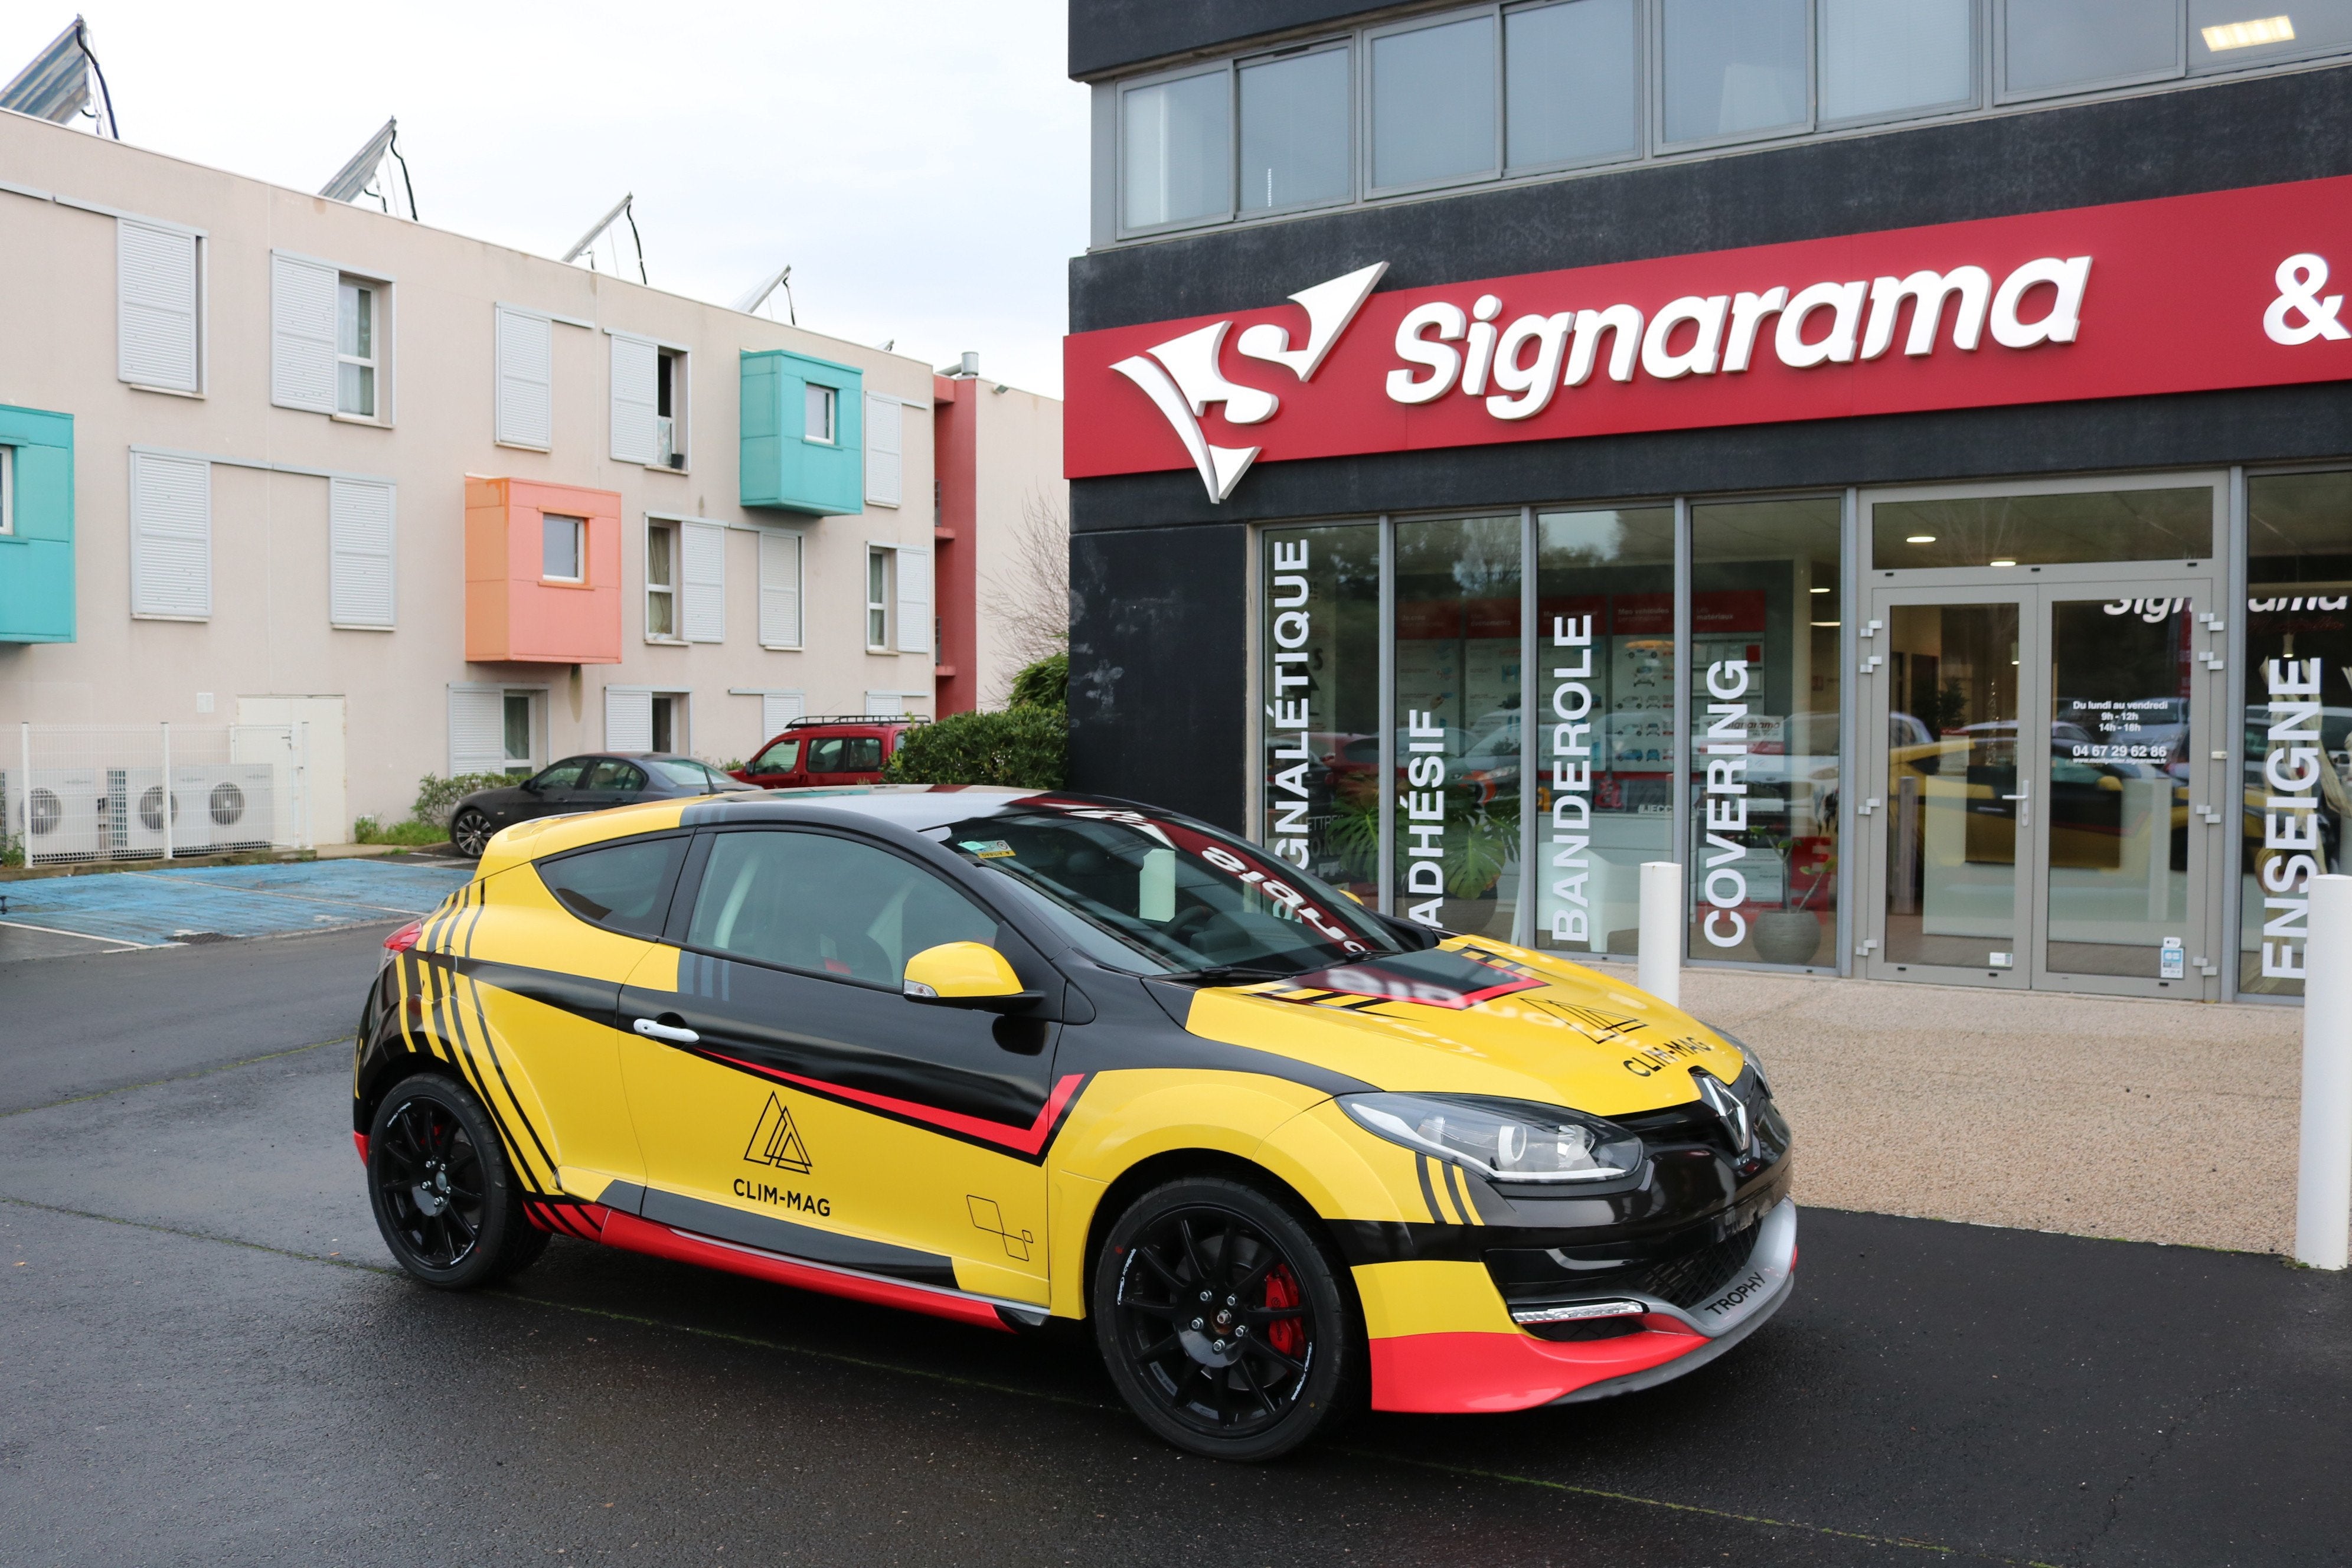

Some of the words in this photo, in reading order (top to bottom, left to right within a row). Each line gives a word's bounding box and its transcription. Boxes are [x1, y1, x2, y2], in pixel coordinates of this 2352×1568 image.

[1386, 255, 2093, 420] Signarama
[2263, 253, 2352, 345] &
[1267, 540, 1309, 871] GNALÉTIQUE
[2073, 701, 2087, 709] Du
[2088, 701, 2112, 709] lundi
[2099, 723, 2116, 731] 14h
[2124, 723, 2141, 731] 18h
[2101, 712, 2113, 720] 9h
[2121, 712, 2138, 720] 12h
[2072, 745, 2089, 757] 04
[2092, 745, 2108, 757] 67
[2111, 745, 2128, 757] 29
[2130, 745, 2147, 757] 62
[2150, 745, 2167, 757] 86
[1553, 615, 1592, 942] BANDEROLE
[1399, 709, 1445, 929] ADHÉSIF
[1704, 659, 1748, 948] COVERING
[2262, 658, 2321, 978] ENSEIGNE
[1622, 1037, 1710, 1077] CLIM-MAG
[733, 1178, 831, 1217] CLIM-MAG
[1704, 1271, 1766, 1317] TROPHY
